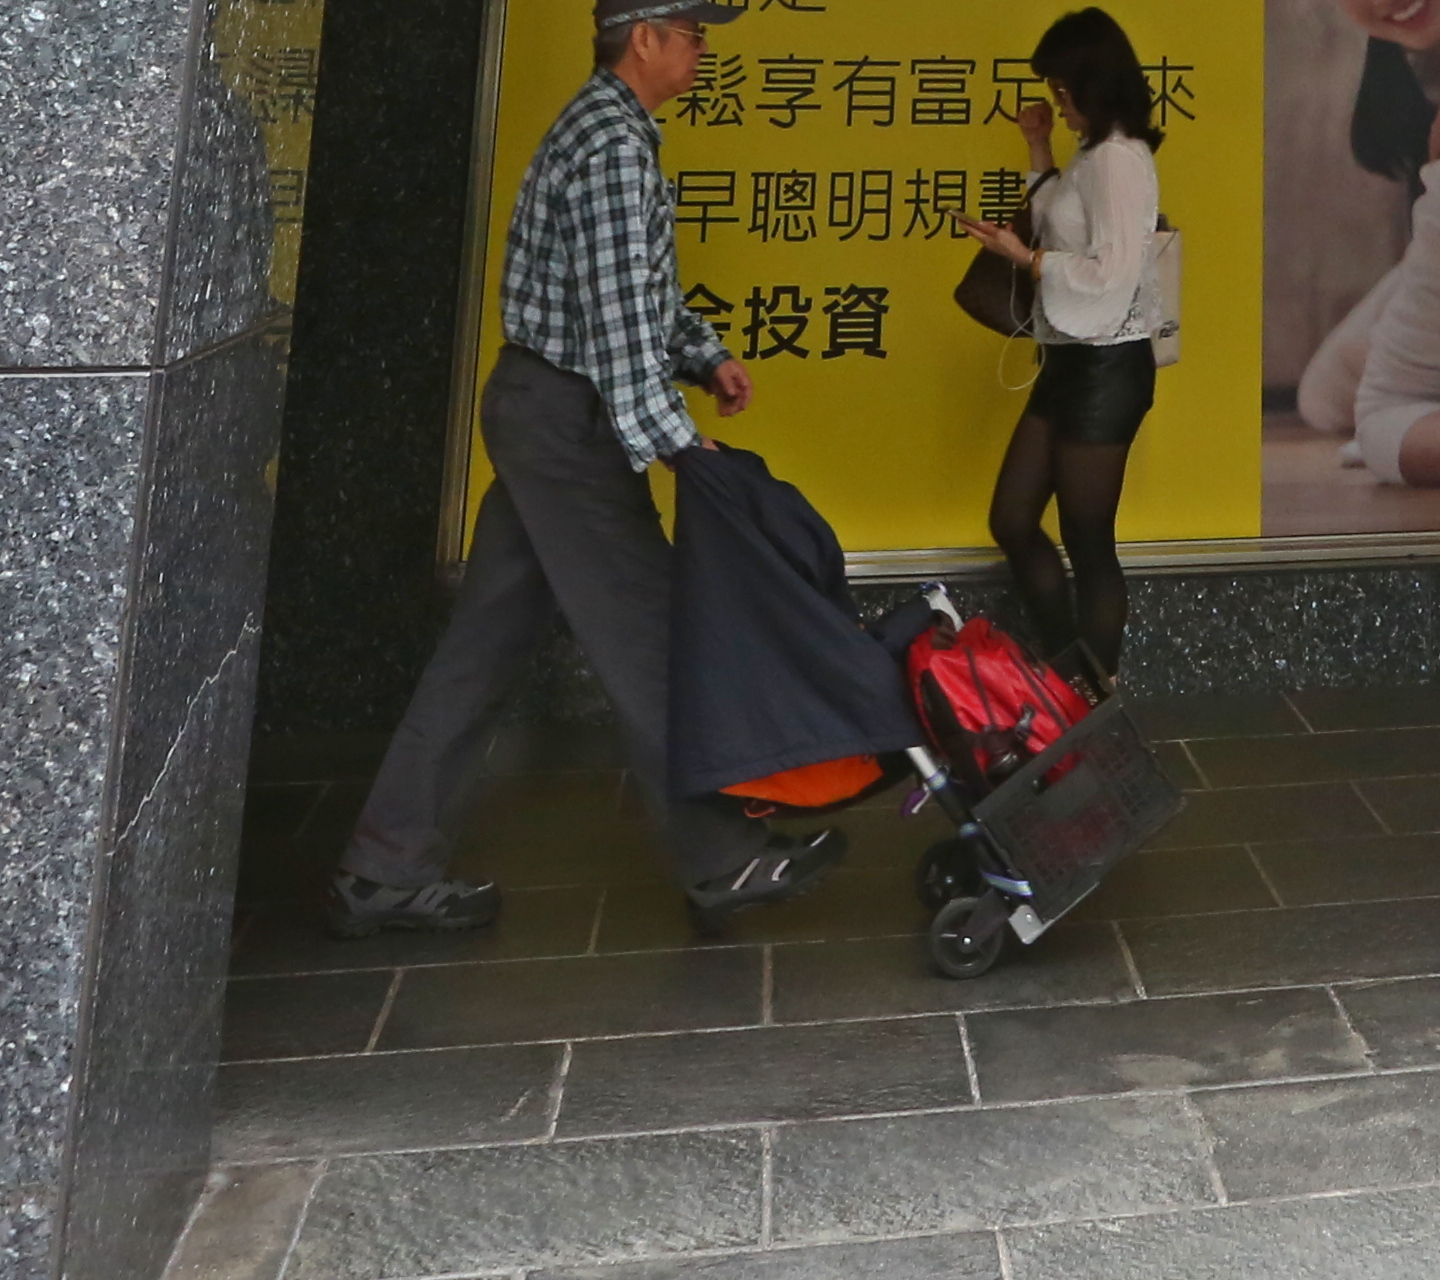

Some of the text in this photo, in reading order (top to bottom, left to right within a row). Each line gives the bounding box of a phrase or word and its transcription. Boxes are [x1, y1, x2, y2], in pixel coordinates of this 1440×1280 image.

[653, 52, 1196, 129] 鬆享有富足來
